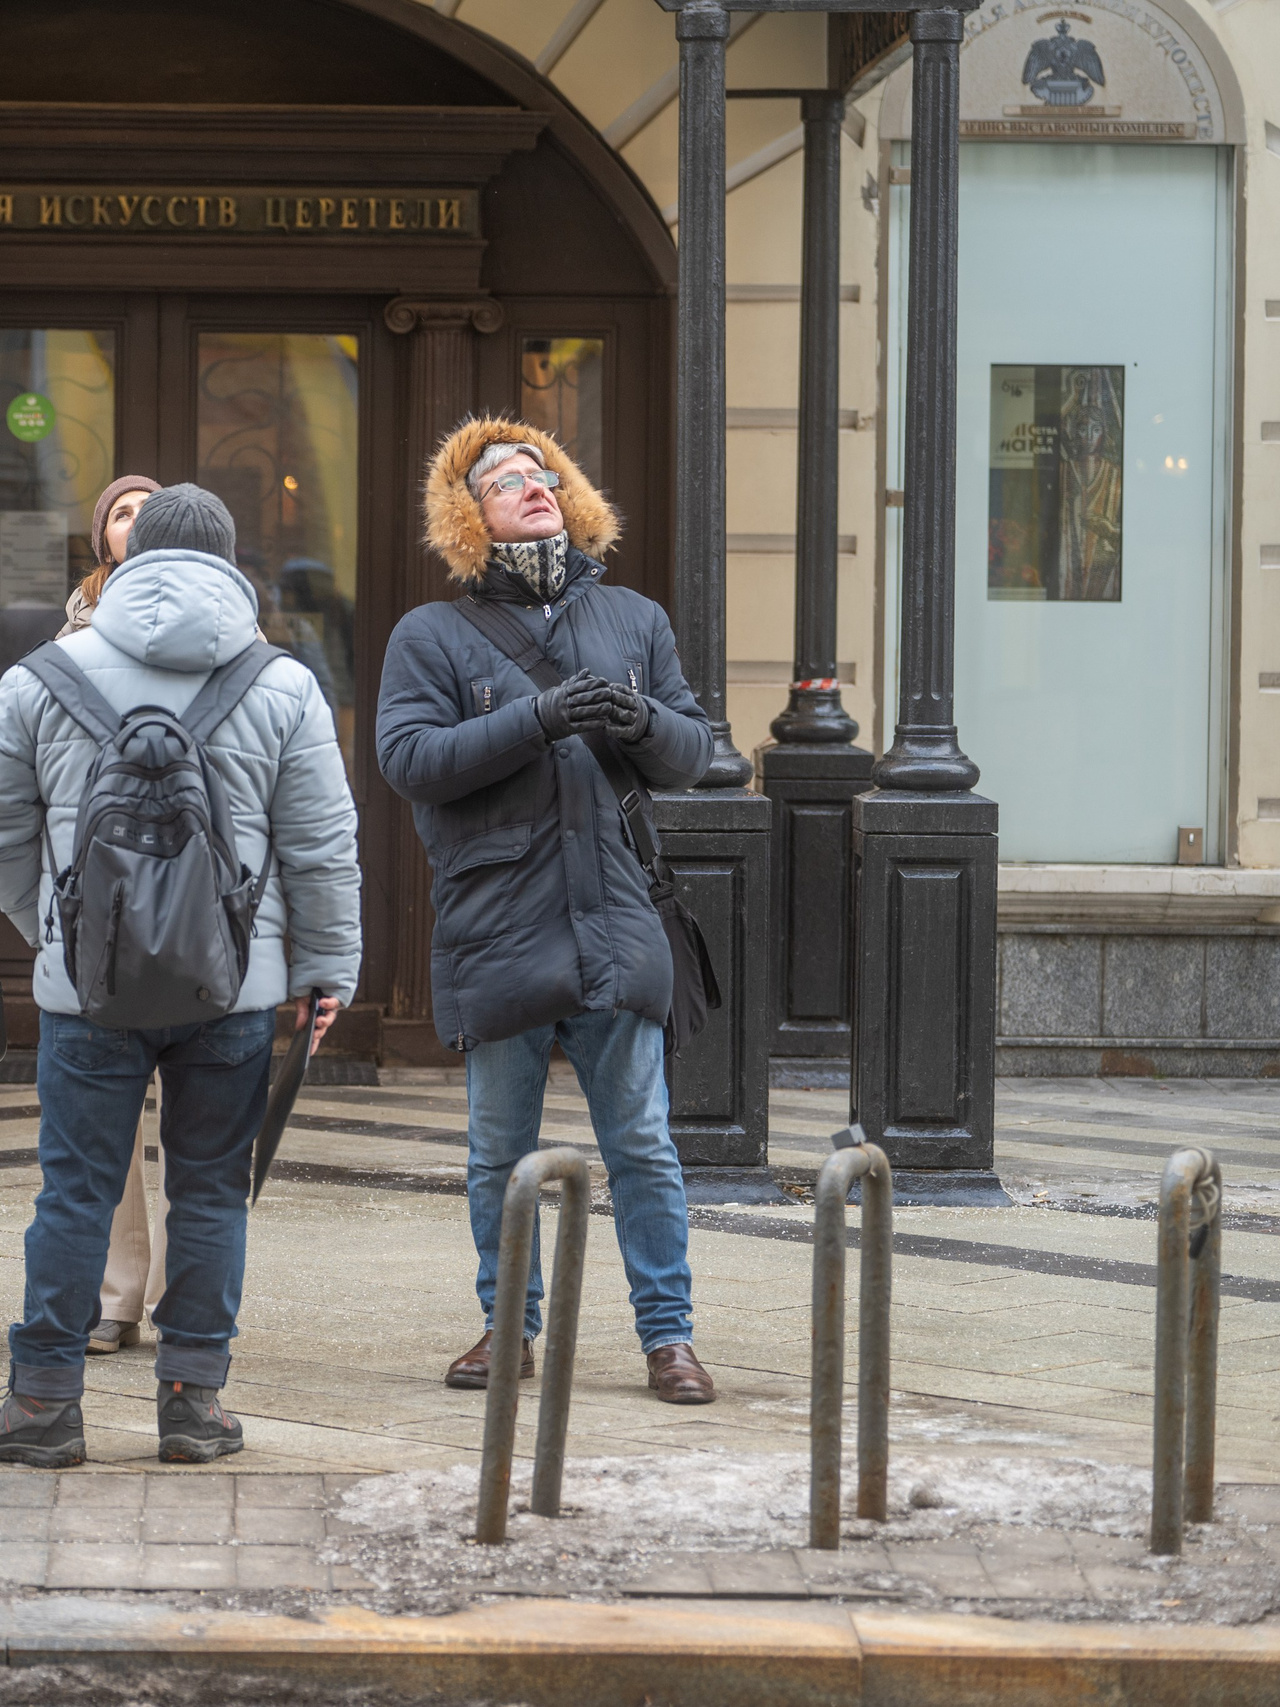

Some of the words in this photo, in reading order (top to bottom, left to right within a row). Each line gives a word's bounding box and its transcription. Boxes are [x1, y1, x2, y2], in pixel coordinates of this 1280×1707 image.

[1113, 122, 1183, 135] КОМПЛЕКС
[39, 194, 237, 227] ИСКУССТВ
[265, 196, 461, 231] ЦЕРЕТЕЛИ
